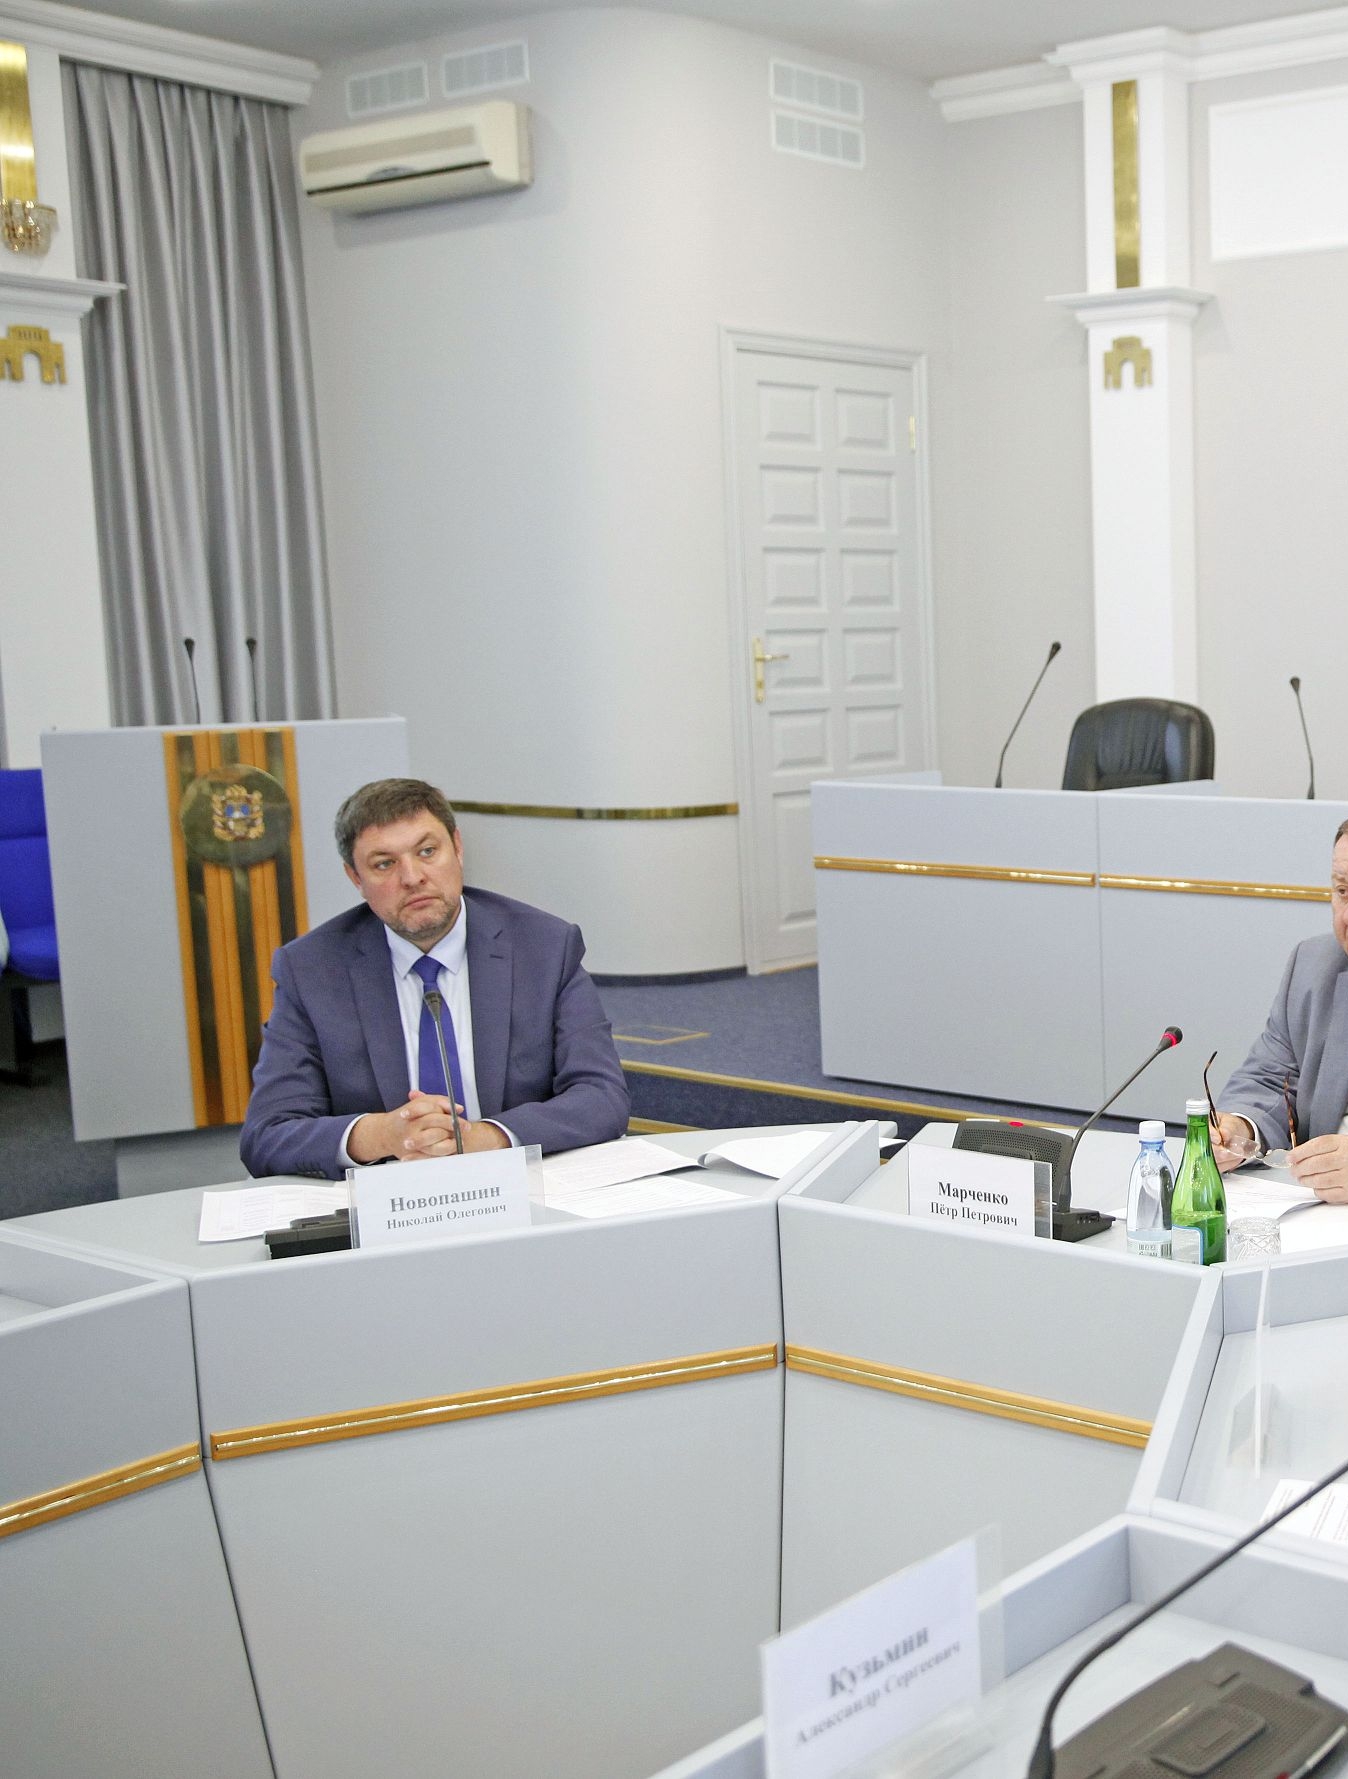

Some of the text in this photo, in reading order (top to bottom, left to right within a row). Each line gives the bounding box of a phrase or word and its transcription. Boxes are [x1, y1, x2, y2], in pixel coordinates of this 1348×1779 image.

[390, 1187, 500, 1212] Новопашин
[937, 1181, 1009, 1206] Марченко
[387, 1204, 506, 1229] Николай Олегович
[931, 1202, 1017, 1226] Пётр Петрович
[829, 1627, 929, 1697] Кузьмин
